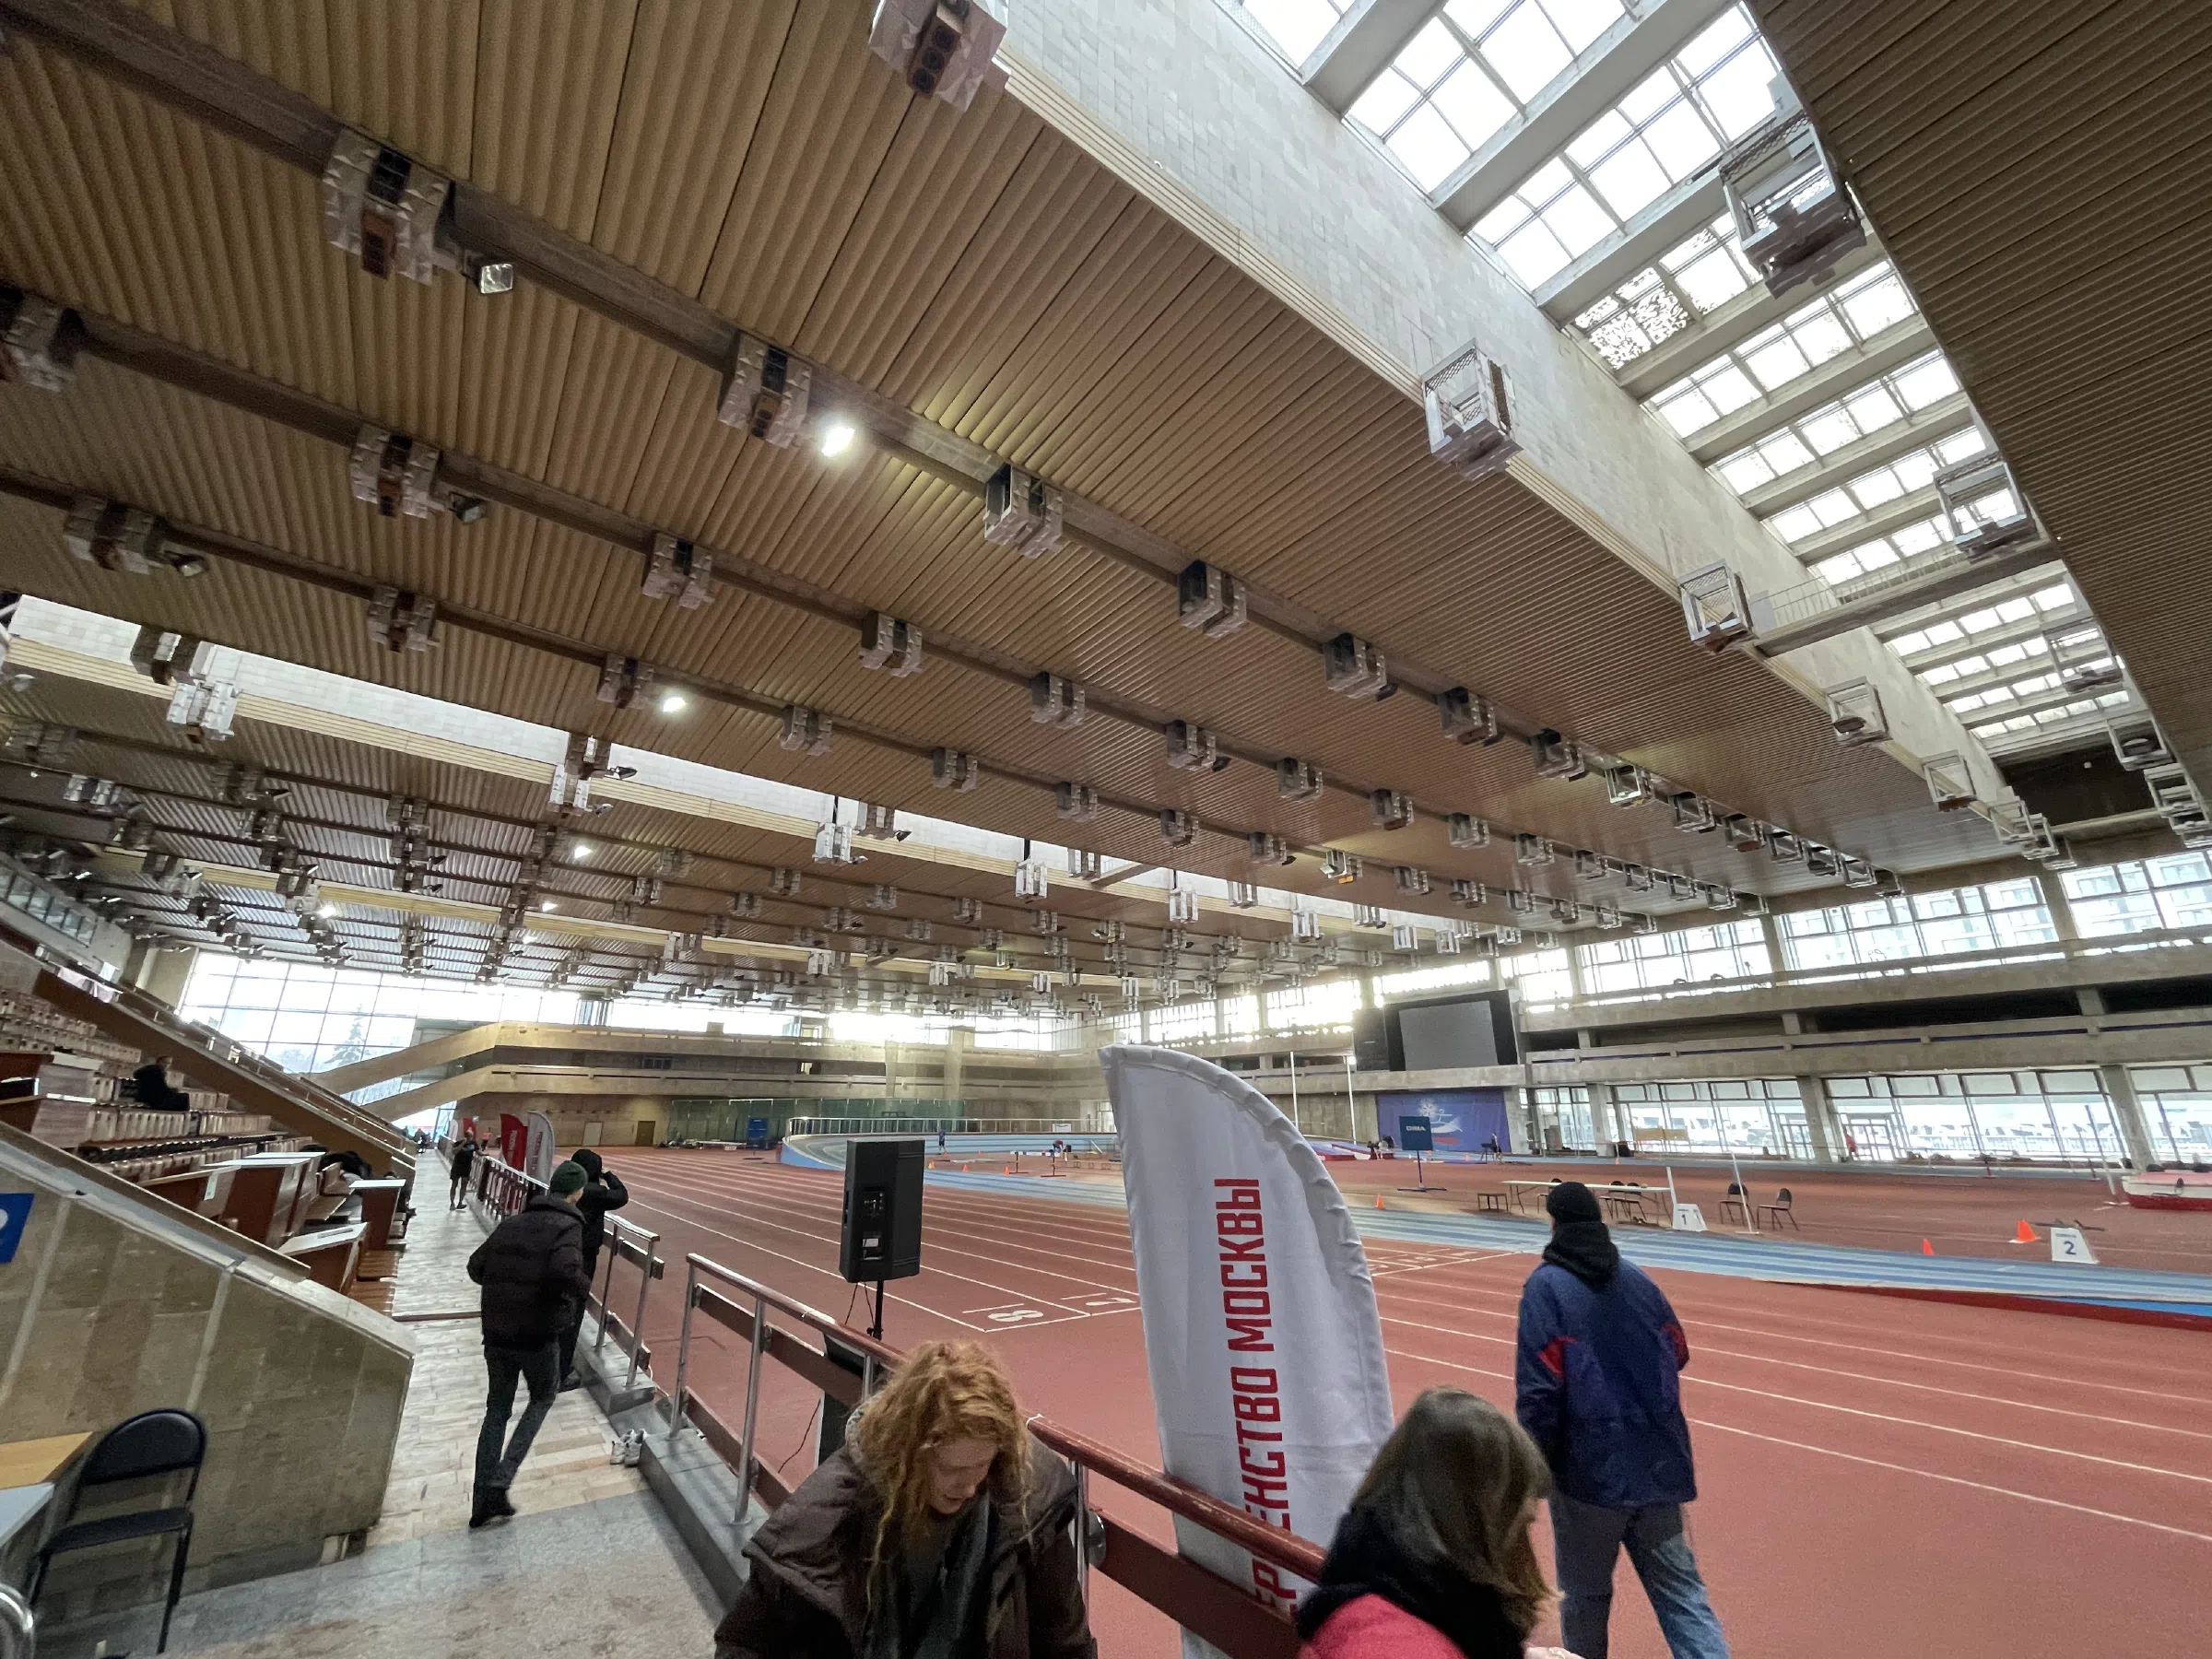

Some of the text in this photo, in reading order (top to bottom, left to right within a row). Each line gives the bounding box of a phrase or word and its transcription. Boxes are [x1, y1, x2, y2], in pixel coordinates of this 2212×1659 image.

[1681, 1214, 1687, 1225] 1
[2063, 1240, 2077, 1255] 2
[1214, 1178, 1275, 1352] МОСКВЫ
[987, 1309, 1044, 1323] 8
